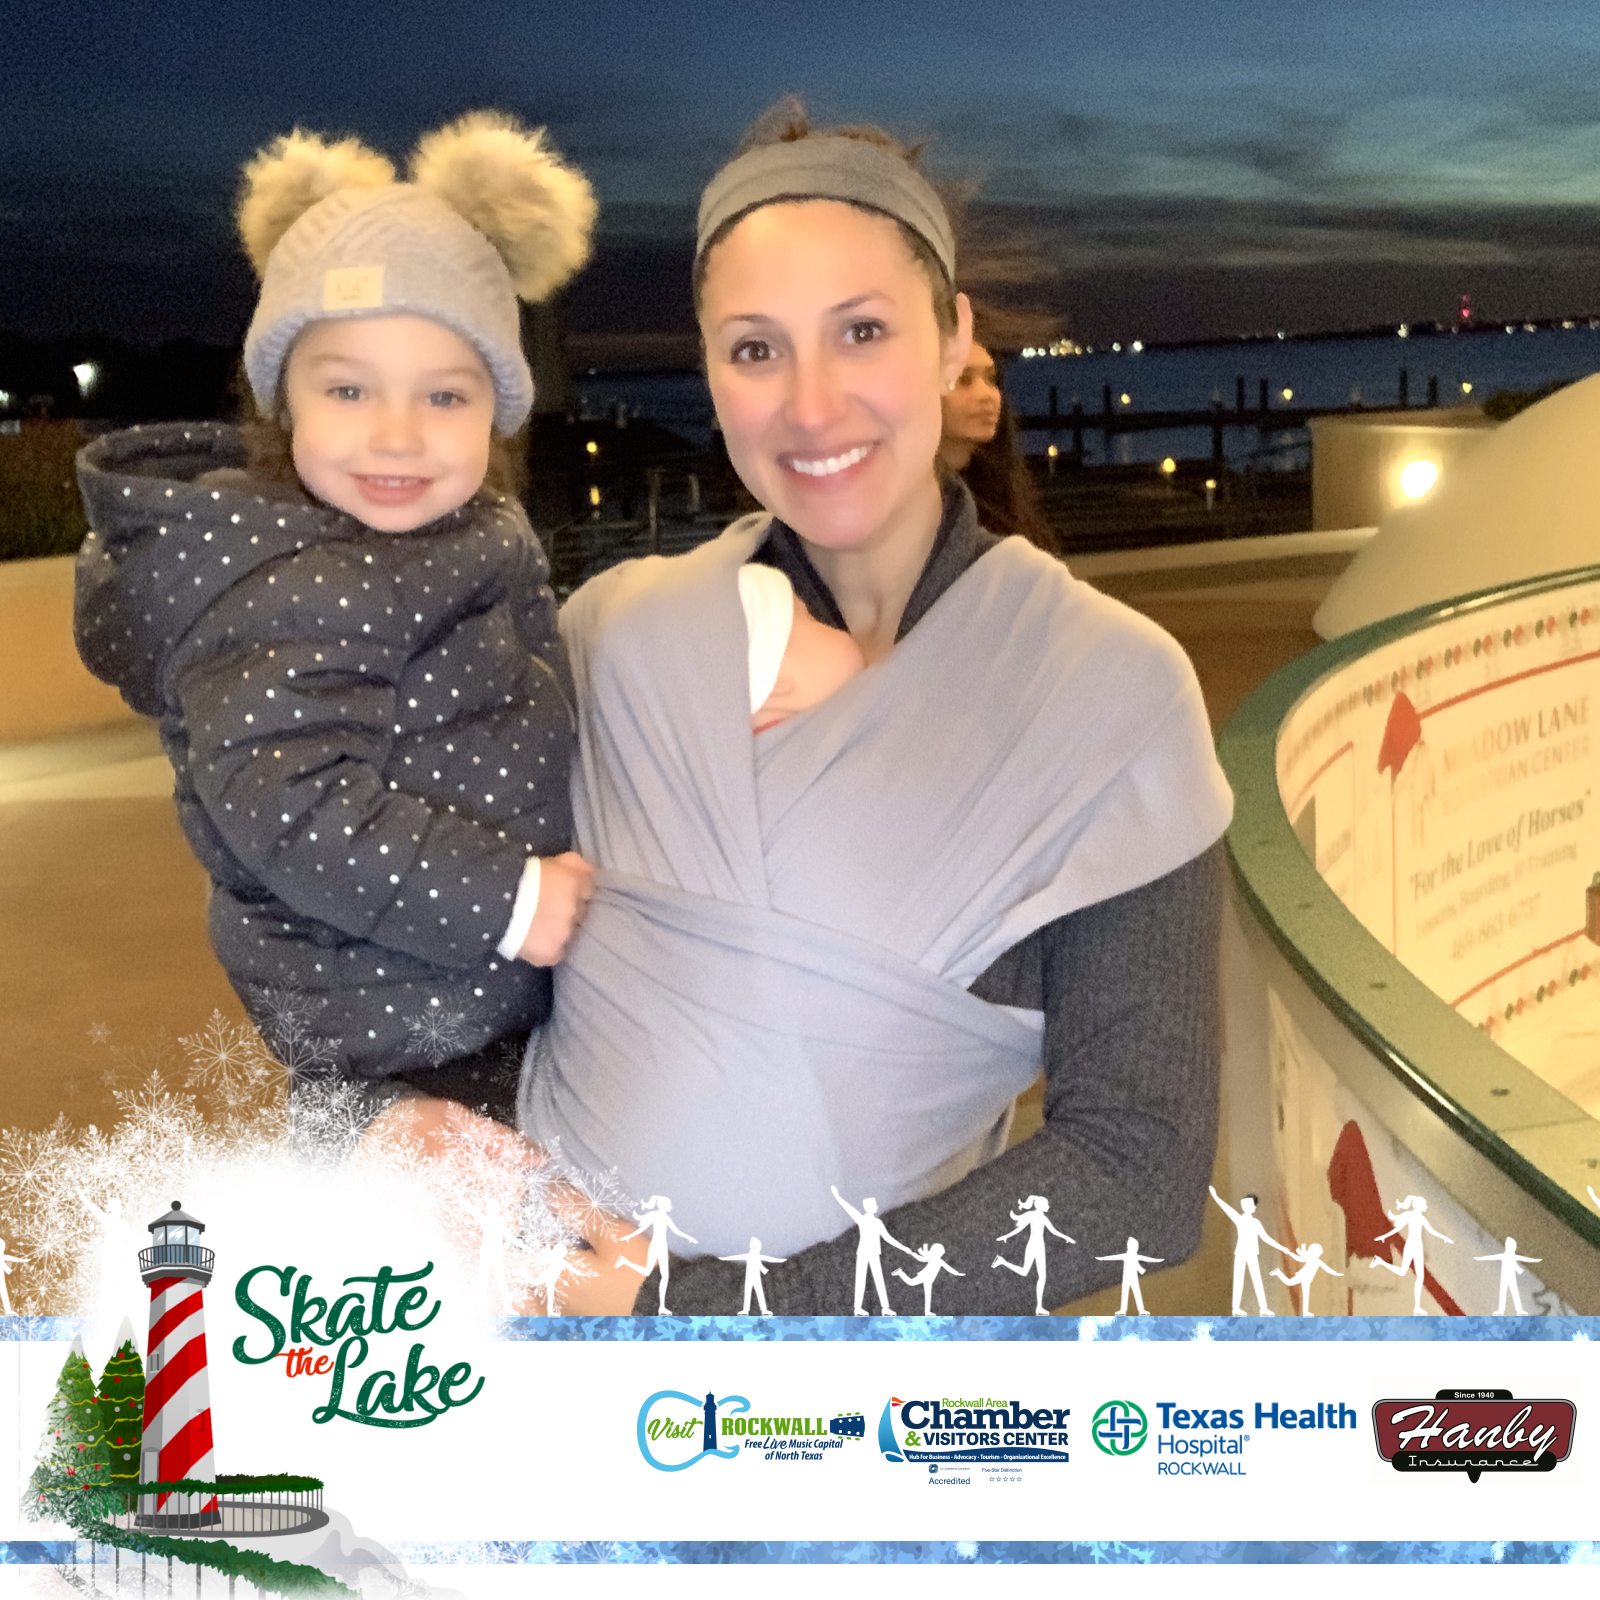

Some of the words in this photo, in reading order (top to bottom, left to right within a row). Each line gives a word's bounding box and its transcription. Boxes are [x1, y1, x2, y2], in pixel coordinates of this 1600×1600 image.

[1538, 694, 1590, 738] LANE
[1531, 735, 1591, 777] CENTER
[1441, 850, 1464, 884] the
[1467, 831, 1504, 869] Love
[1506, 811, 1526, 853] of
[1528, 786, 1592, 838] Horses"
